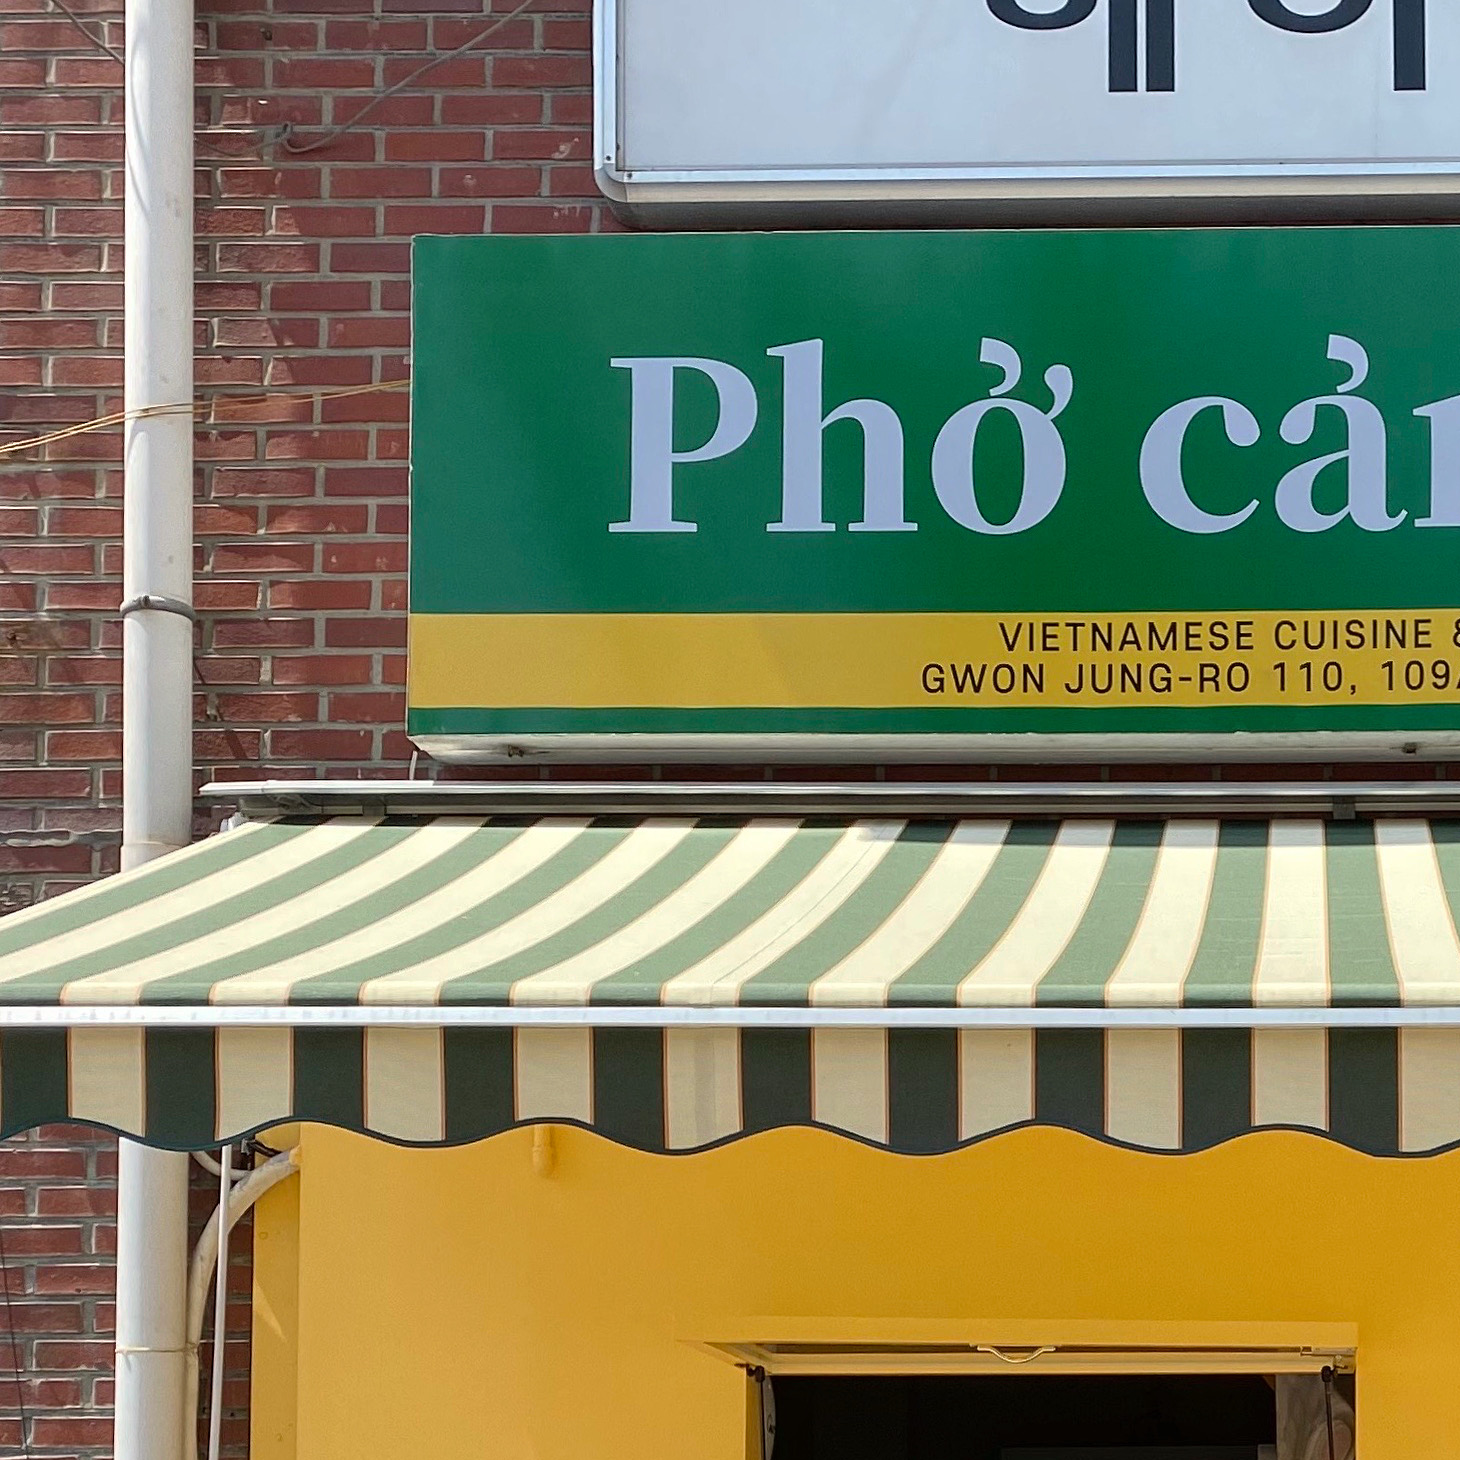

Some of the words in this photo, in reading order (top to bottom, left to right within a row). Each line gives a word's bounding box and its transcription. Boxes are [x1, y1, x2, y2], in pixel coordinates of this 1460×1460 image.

[608, 337, 1074, 535] Phở
[998, 620, 1255, 652] VIETNAMESE
[1274, 617, 1433, 650] CUISINE
[921, 663, 1046, 695] GWON
[1064, 661, 1251, 694] JUNG-RO
[1273, 660, 1358, 697] 110,
